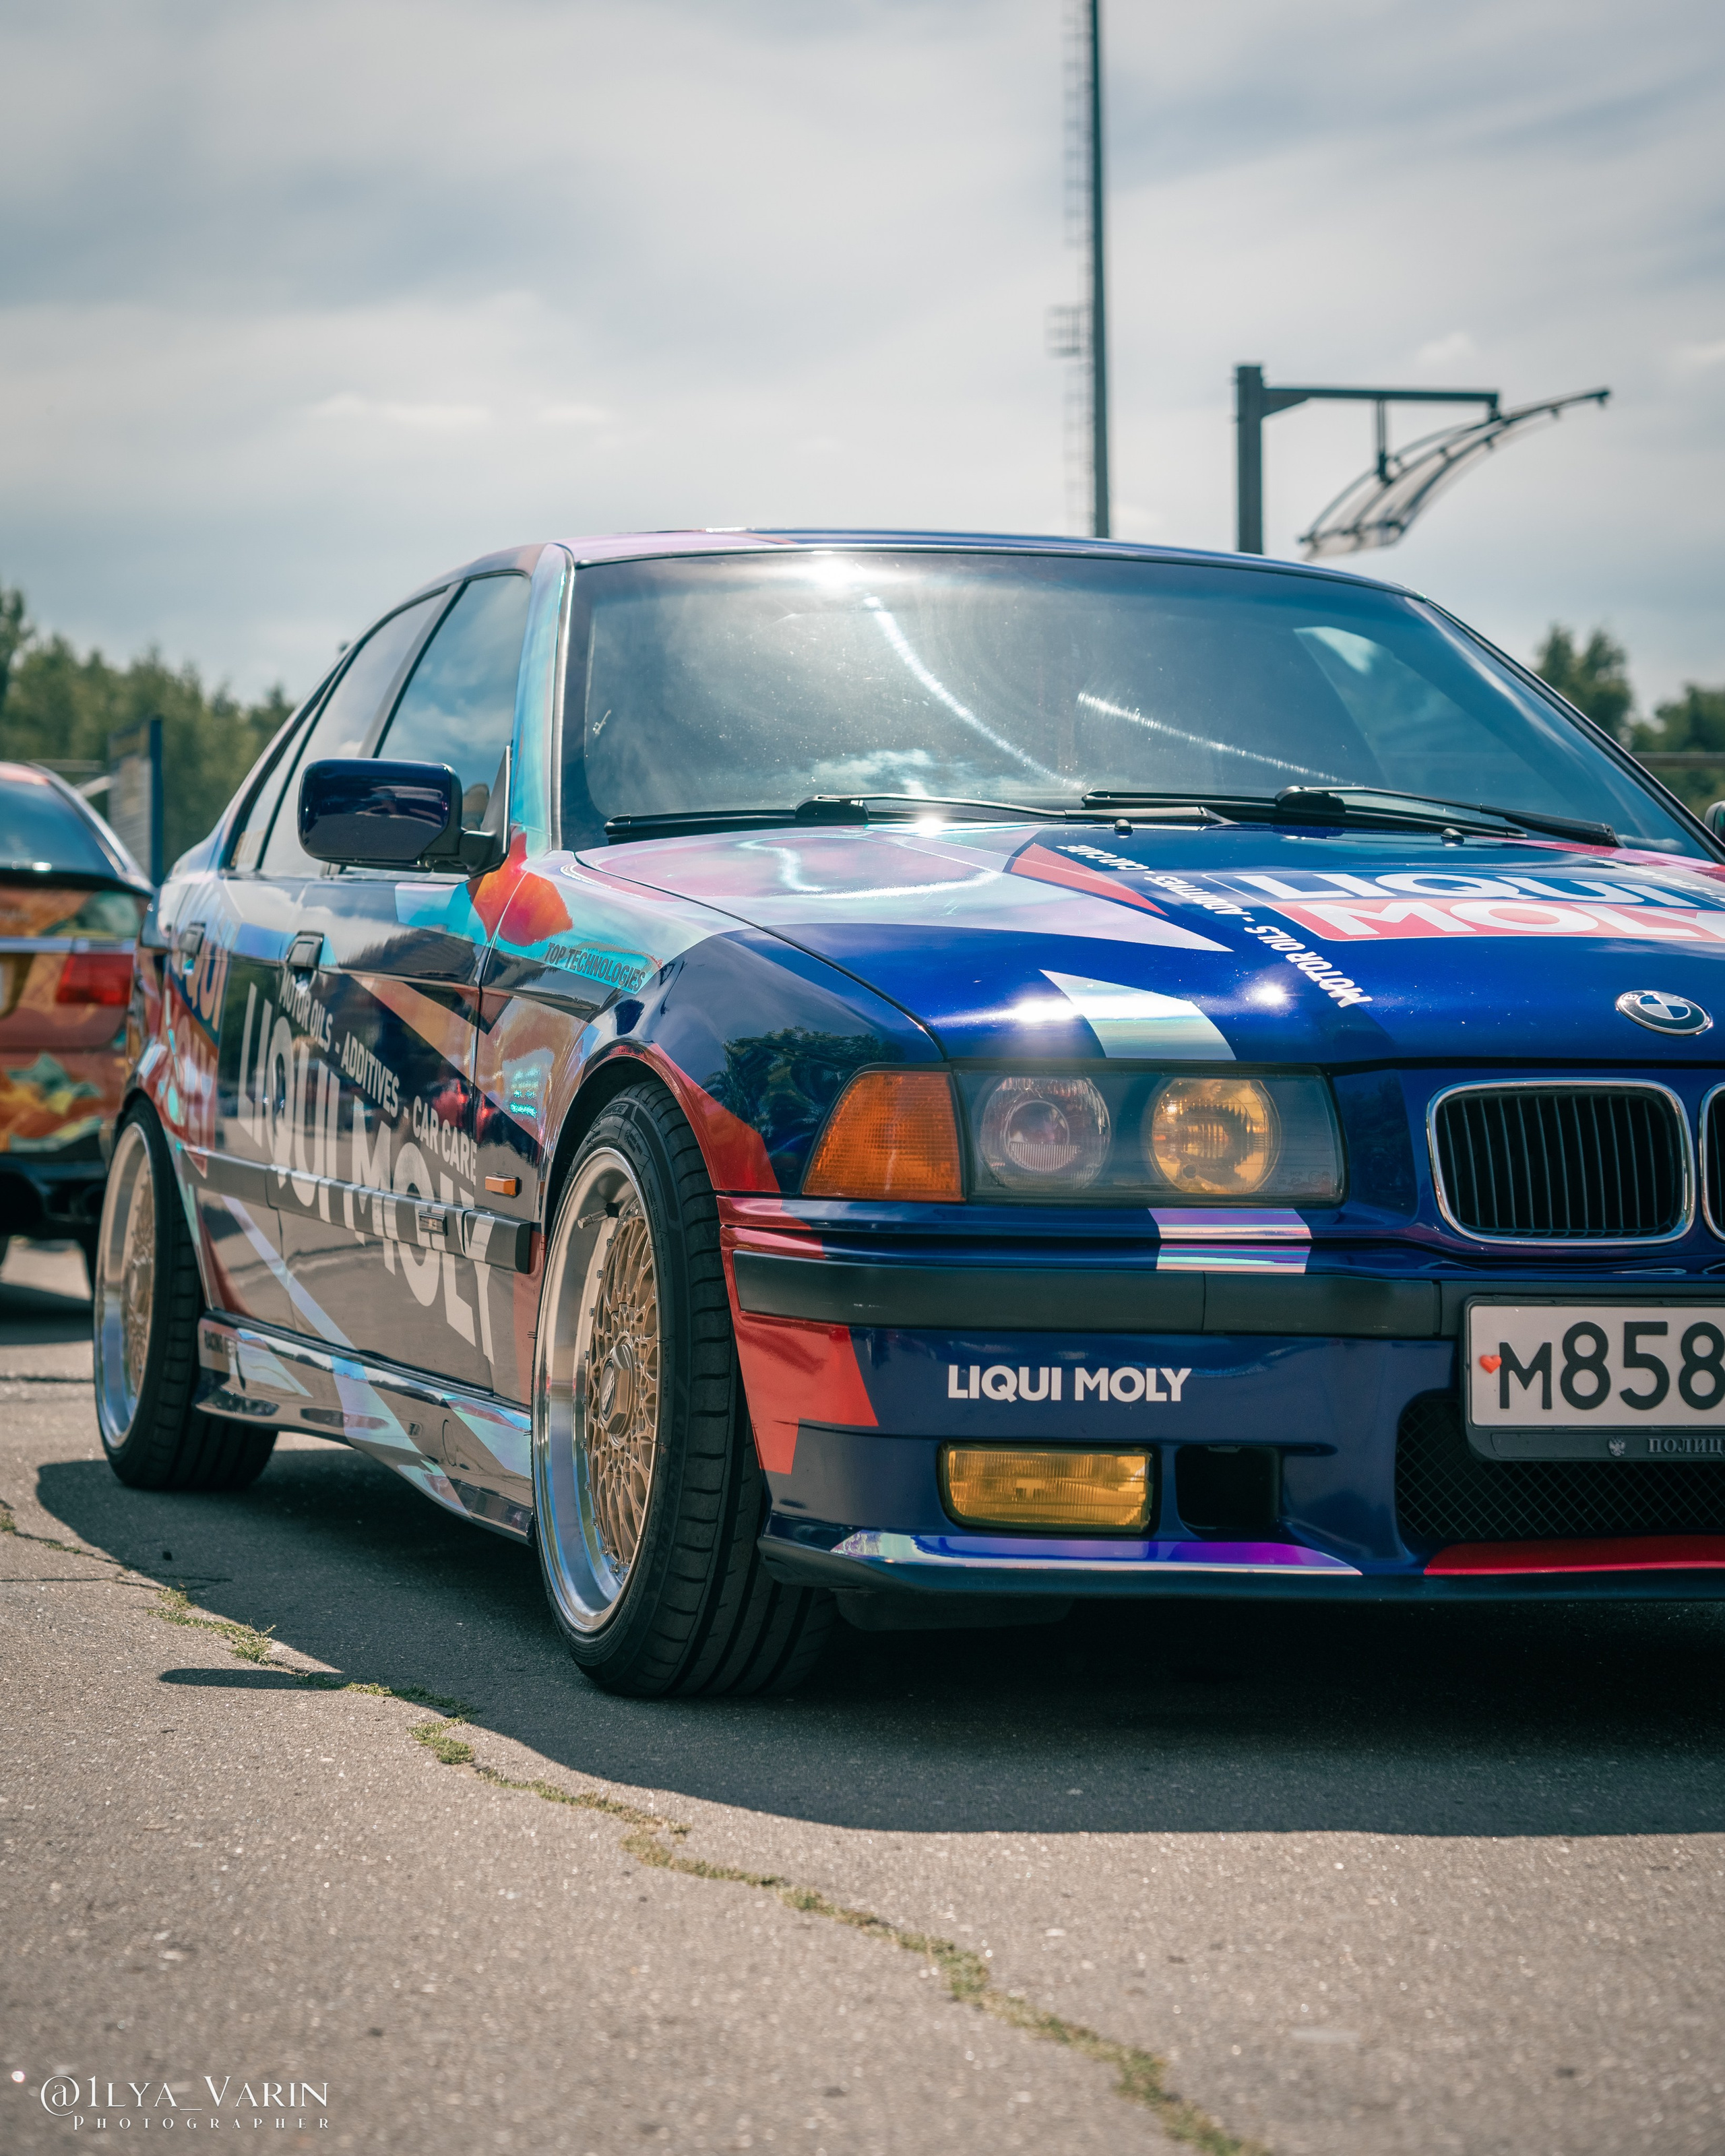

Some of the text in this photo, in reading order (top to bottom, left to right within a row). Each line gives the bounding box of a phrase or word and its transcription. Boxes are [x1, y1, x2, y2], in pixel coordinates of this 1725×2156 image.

[1143, 875, 1252, 915] ADDITIVES
[1232, 873, 1702, 908] LIQUI
[1244, 926, 1306, 951] OILS
[1297, 901, 1725, 939] MOLY
[544, 942, 646, 992] TOP TECHNOLOGIES
[1285, 951, 1373, 1008] MOTOR
[279, 966, 312, 1032] MOTOR
[310, 999, 334, 1052] OILS
[340, 1031, 400, 1118] ADDITIVES
[413, 1096, 439, 1155] CAR
[441, 1119, 477, 1186] CARE
[238, 982, 496, 1366] LIQUI MOLY
[948, 1364, 1192, 1403] LIQUI MOLY
[1647, 1438, 1725, 1456] ПОЛИЦ
